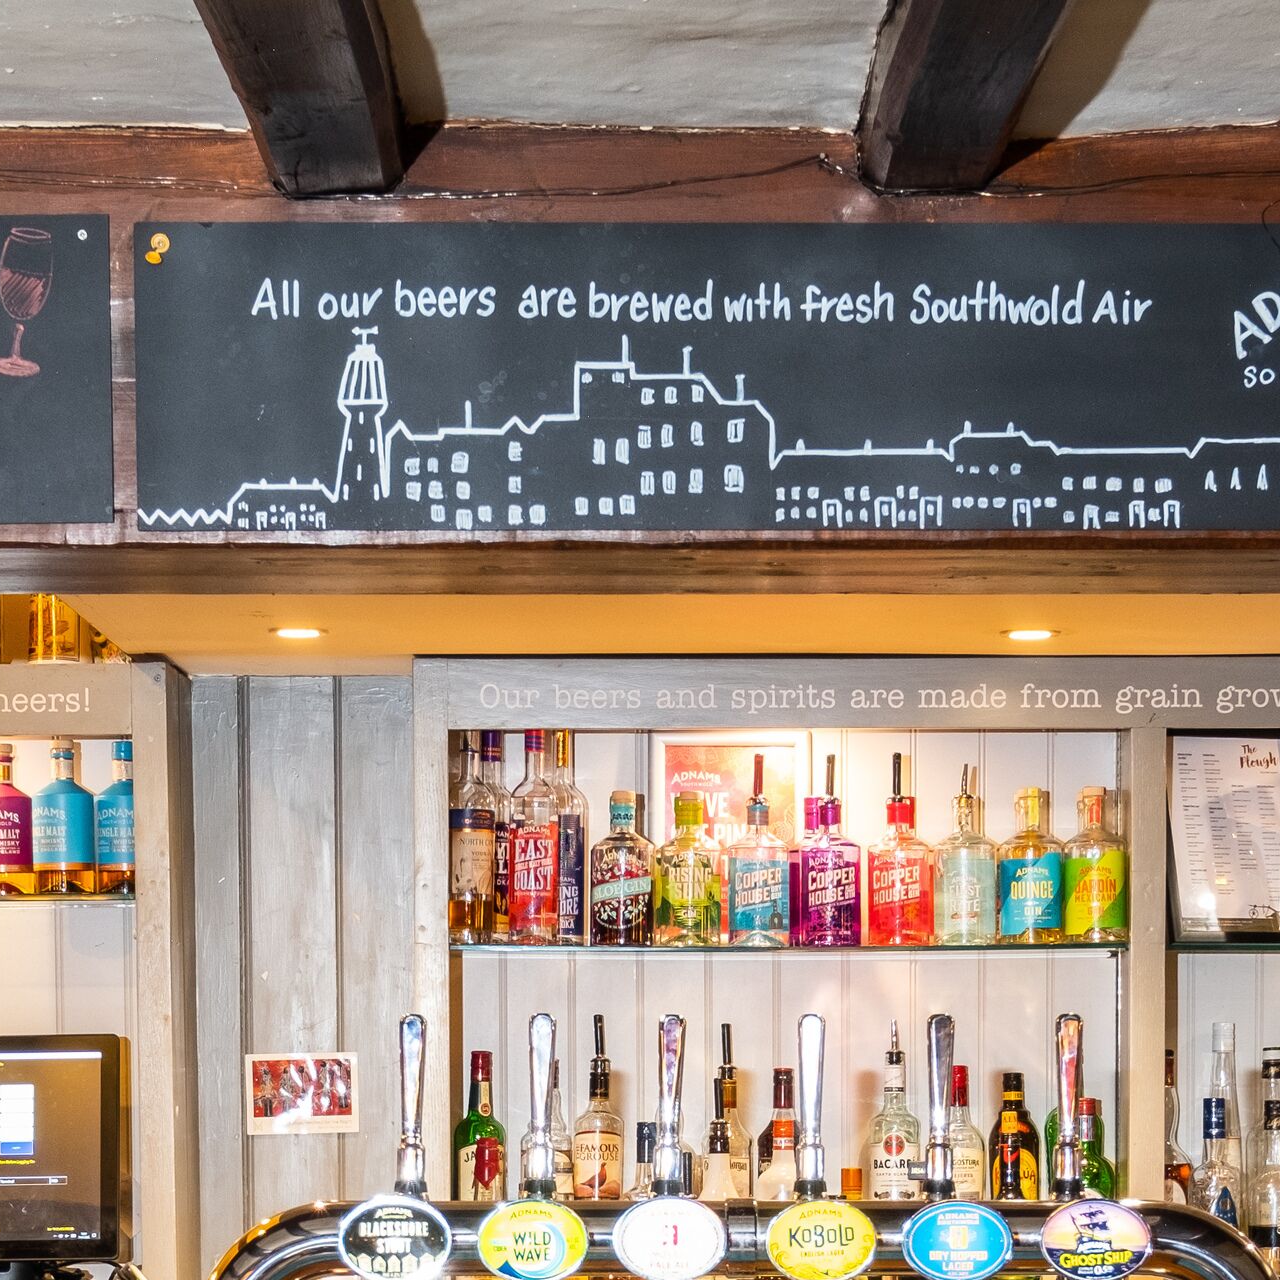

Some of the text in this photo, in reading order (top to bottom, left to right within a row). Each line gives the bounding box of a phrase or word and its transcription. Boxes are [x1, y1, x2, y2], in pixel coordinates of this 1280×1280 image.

[250, 277, 1153, 327] All our beers are brewed with fresh Southwold Air
[479, 683, 541, 711] Our
[554, 684, 643, 711] beers
[656, 683, 716, 710] and
[730, 683, 837, 715] spirits
[850, 687, 905, 710] are
[918, 682, 1008, 709] made
[1020, 682, 1101, 711] from
[1114, 684, 1201, 713] grain
[1241, 744, 1257, 754] The
[1239, 752, 1277, 769] Plough
[0, 829, 20, 839] MALT
[514, 838, 554, 862] EAST
[514, 865, 554, 890] COAST
[669, 867, 712, 881] RISING
[735, 867, 781, 889] COPPER
[808, 867, 855, 891] COPPER
[873, 866, 919, 889] COPPER
[624, 878, 648, 894] GIN
[675, 882, 705, 899] SUN
[873, 885, 907, 904] HOUSE
[1010, 881, 1053, 899] QUINCE
[735, 888, 770, 907] HOUSE
[809, 886, 844, 906] HOUSE
[1024, 907, 1041, 915] GIN
[579, 1144, 619, 1152] FAMOUS
[579, 1152, 619, 1161] GROUSE
[359, 1221, 429, 1237] BLACKSHORE
[789, 1224, 854, 1249] KOBOLD
[377, 1238, 411, 1253] STOUT
[513, 1248, 550, 1261] WAVE
[1060, 1250, 1133, 1268] GHOST SHIP
[942, 1262, 973, 1270] LAGER
